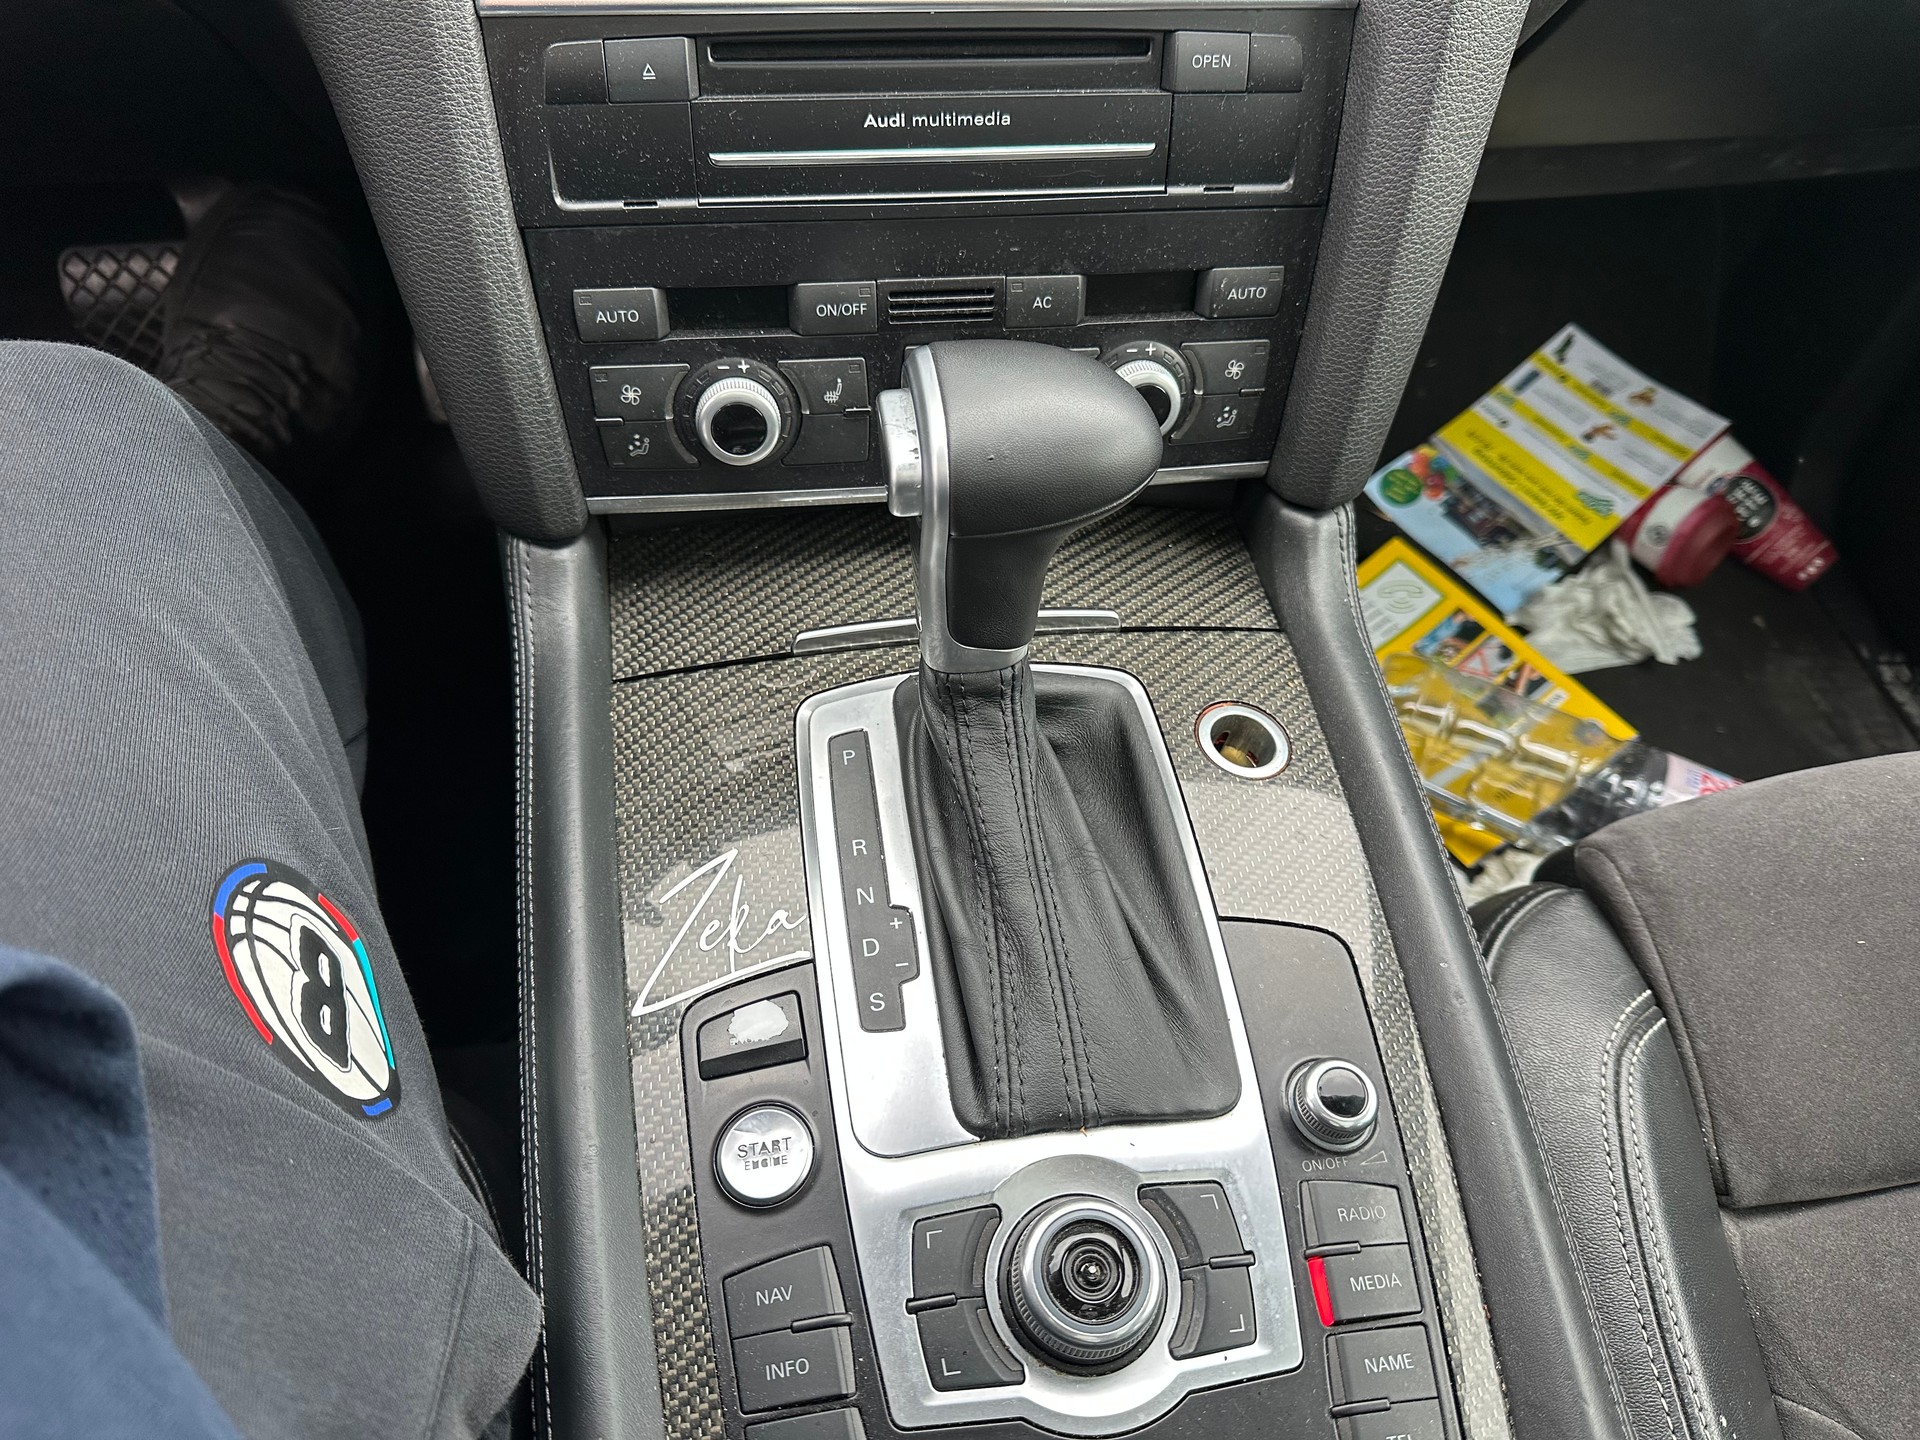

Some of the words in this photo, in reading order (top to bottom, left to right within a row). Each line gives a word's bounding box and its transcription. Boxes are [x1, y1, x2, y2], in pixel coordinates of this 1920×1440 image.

[1192, 54, 1231, 69] OPEN
[863, 112, 906, 128] Audi
[912, 110, 1011, 127] multimedia
[1228, 287, 1266, 300] AUTO
[816, 303, 867, 317] ON/OFF
[1033, 297, 1052, 309] AC
[596, 310, 639, 324] AUTO
[842, 749, 855, 765] P
[852, 839, 868, 856] R
[856, 886, 875, 904] N
[631, 849, 811, 1017] Zeka
[862, 938, 880, 957] D
[869, 992, 886, 1011] S
[737, 1136, 792, 1159] START
[744, 1154, 788, 1171] ENGINE
[1301, 1156, 1349, 1172] ON/OFF
[1337, 1205, 1386, 1222] RADIO
[1349, 1272, 1402, 1292] MEDIA
[755, 1284, 793, 1307] NAV
[765, 1358, 810, 1381] INFO
[1364, 1353, 1415, 1374] NAME
